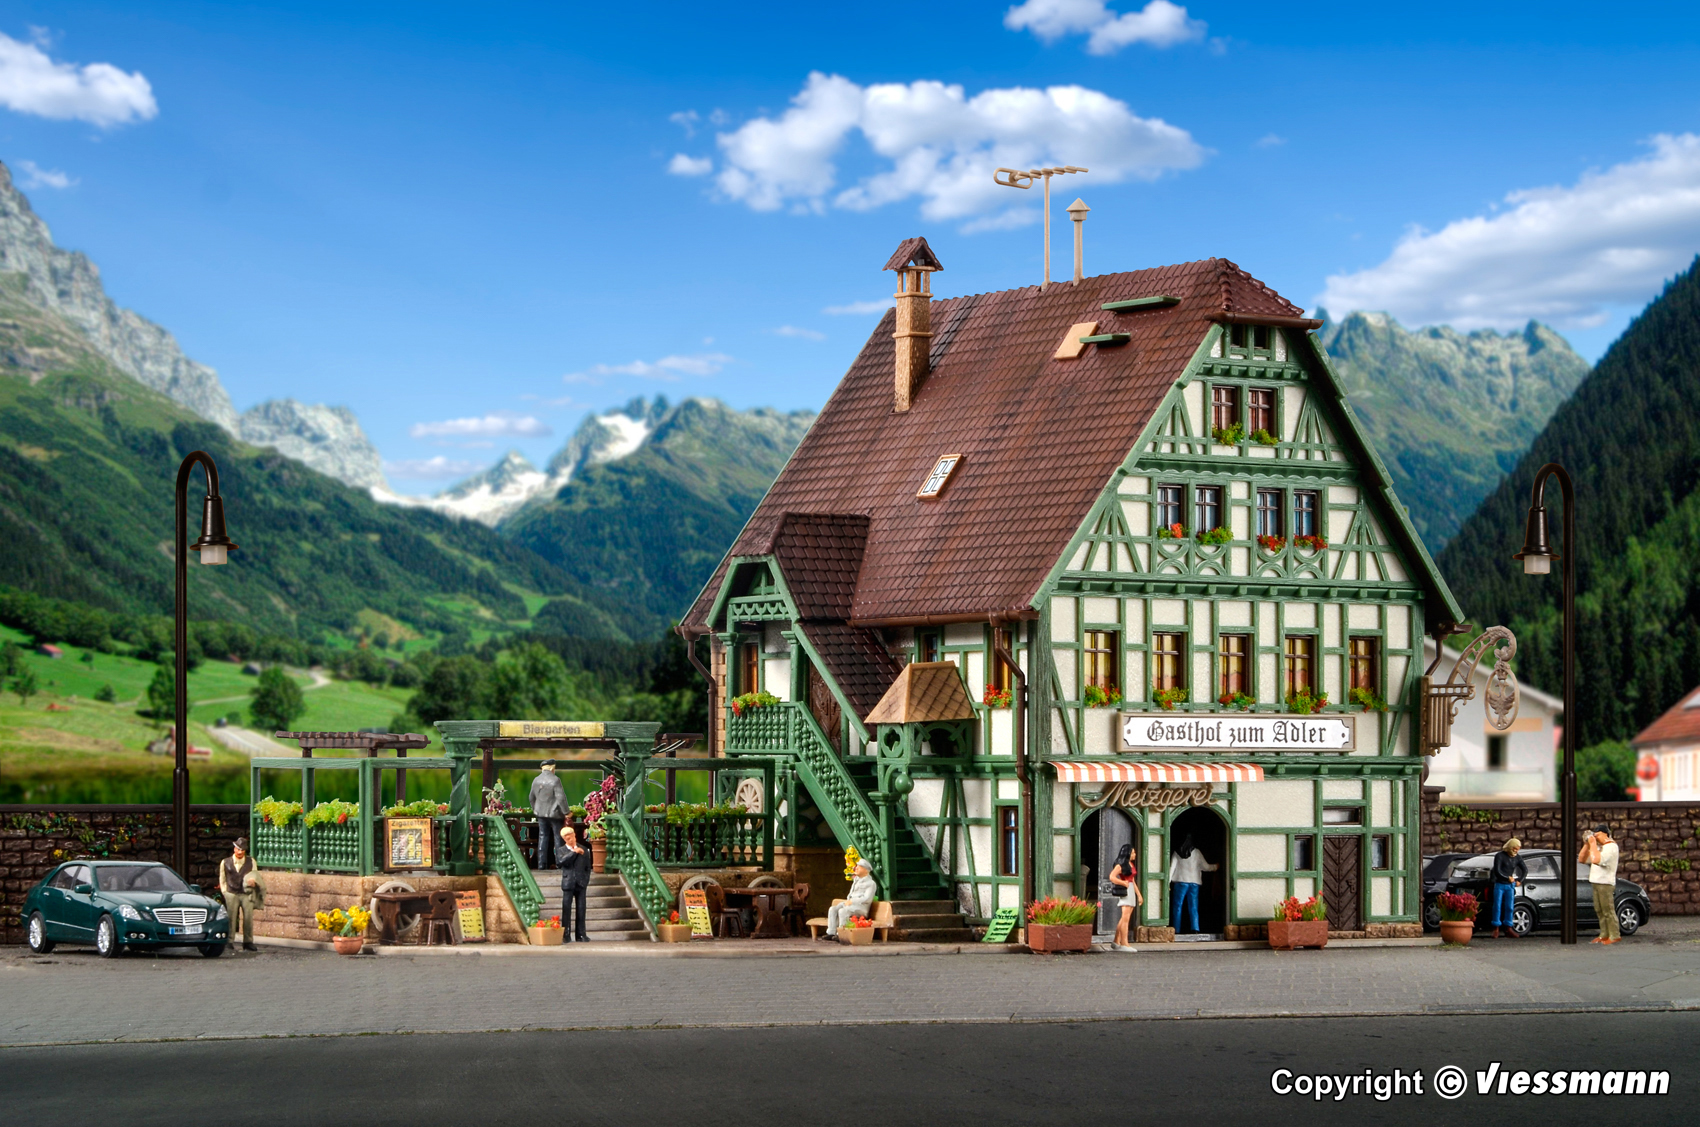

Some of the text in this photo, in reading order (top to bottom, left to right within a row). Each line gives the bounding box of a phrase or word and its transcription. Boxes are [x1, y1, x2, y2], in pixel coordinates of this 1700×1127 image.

[523, 724, 580, 736] Biergarten
[1147, 720, 1326, 747] Gasthof zum Adler
[1078, 781, 1219, 813] Metzgerei
